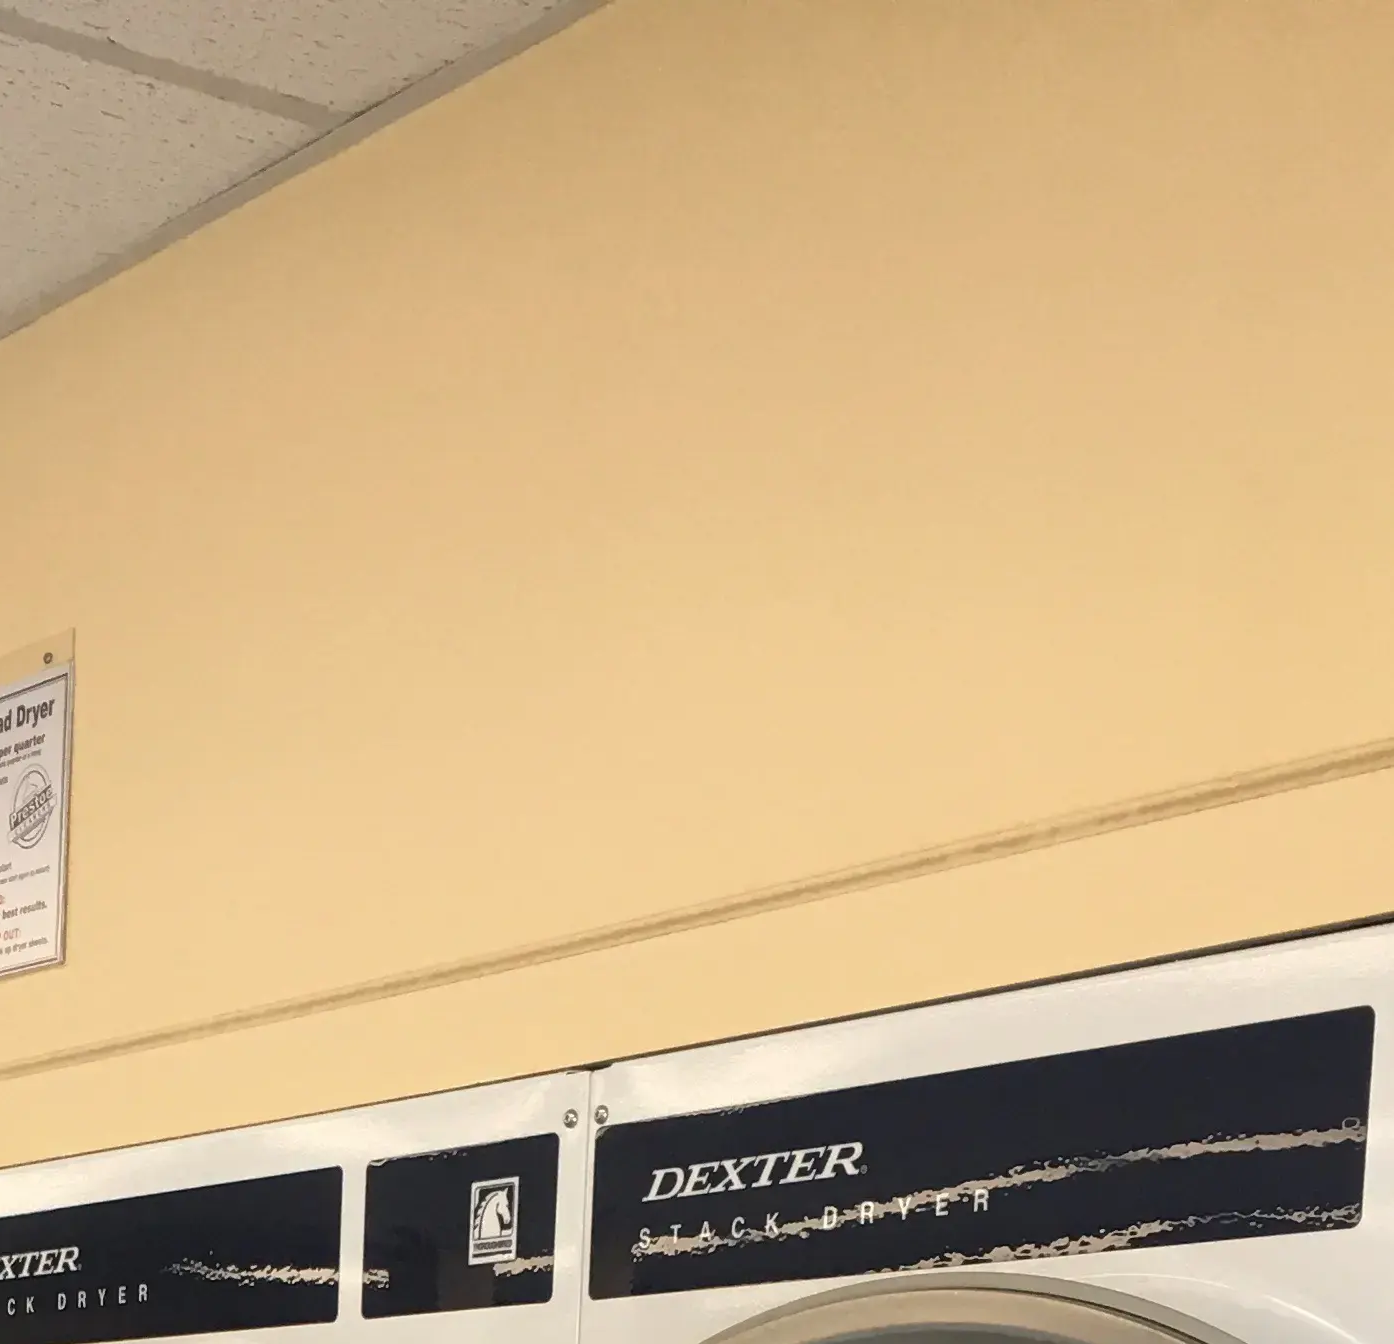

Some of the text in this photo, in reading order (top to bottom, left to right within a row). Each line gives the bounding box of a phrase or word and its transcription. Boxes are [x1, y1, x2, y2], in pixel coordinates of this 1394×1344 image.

[16, 698, 55, 727] Dryer
[13, 733, 45, 754] quarter
[2, 907, 18, 919] best
[642, 1141, 864, 1202] DEXTER
[638, 1188, 990, 1249] STACK DRYER
[57, 1284, 148, 1311] DRYER
